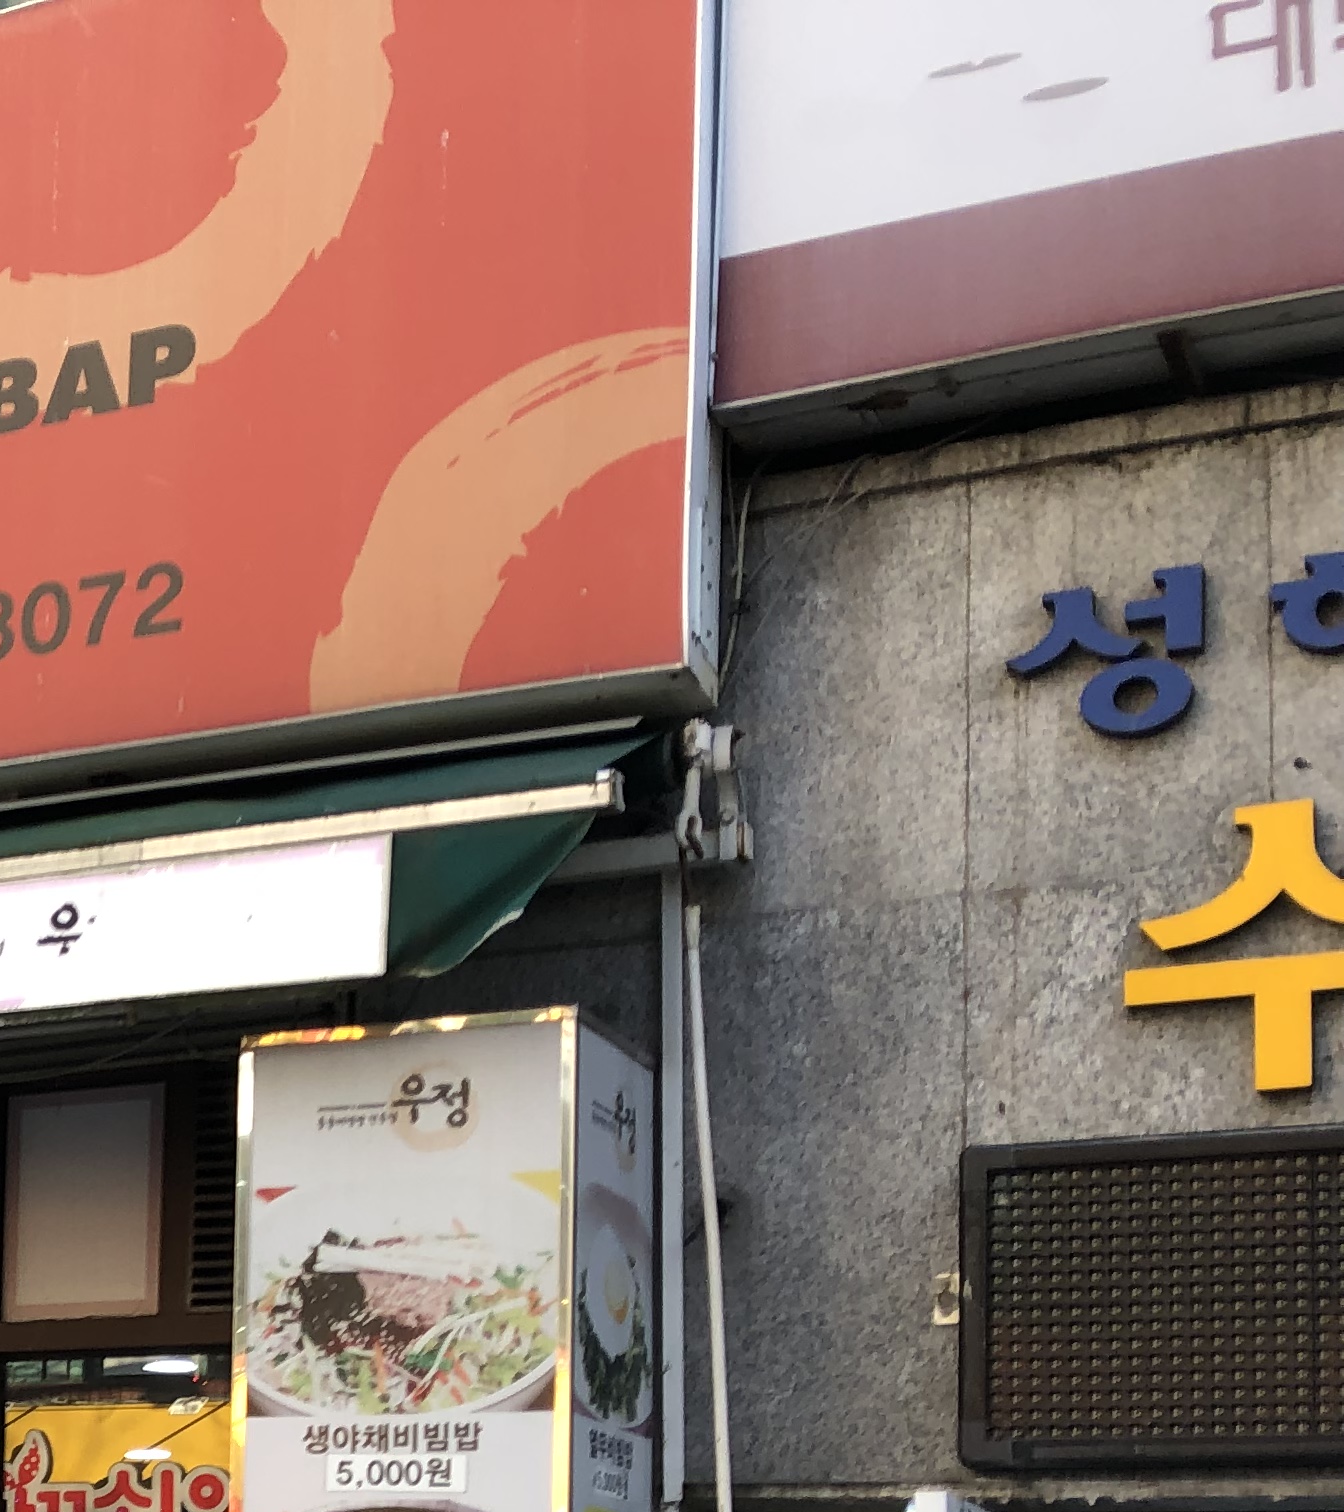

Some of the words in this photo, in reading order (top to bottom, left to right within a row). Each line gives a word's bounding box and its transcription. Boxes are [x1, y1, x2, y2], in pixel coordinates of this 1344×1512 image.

[1210, 0, 1344, 91] 대
[35, 901, 98, 957] 우
[392, 1074, 470, 1128] 우정
[303, 1422, 481, 1456] 생야채비빔밥
[335, 1457, 453, 1489] 5,000원
